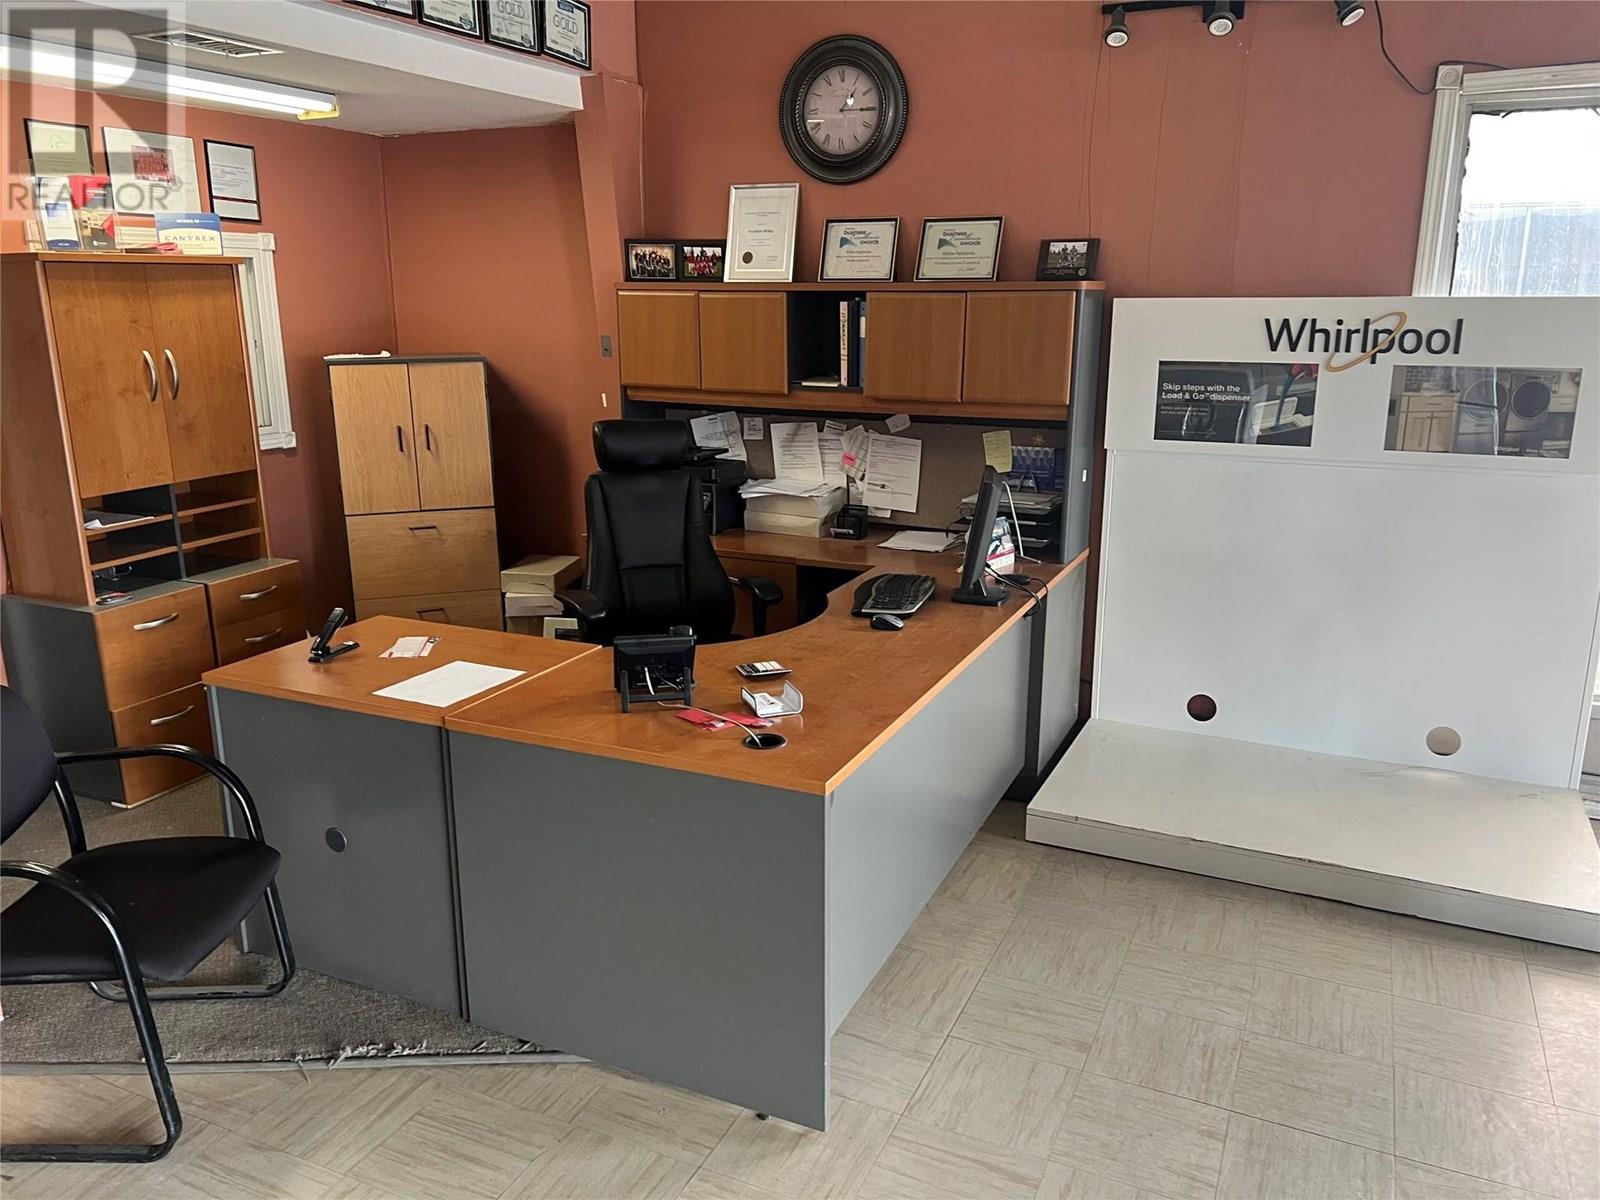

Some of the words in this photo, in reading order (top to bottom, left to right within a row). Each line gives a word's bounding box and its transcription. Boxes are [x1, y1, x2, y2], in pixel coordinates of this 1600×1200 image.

[497, 0, 526, 19] GOLD
[553, 14, 579, 35] GOLD
[1264, 318, 1464, 365] Whirlpool
[1162, 382, 1181, 392] Skip
[1182, 384, 1205, 392] steps
[1206, 384, 1225, 392] with
[1161, 392, 1183, 400] Load
[1184, 392, 1190, 400] &
[1209, 392, 1252, 402] dispenser
